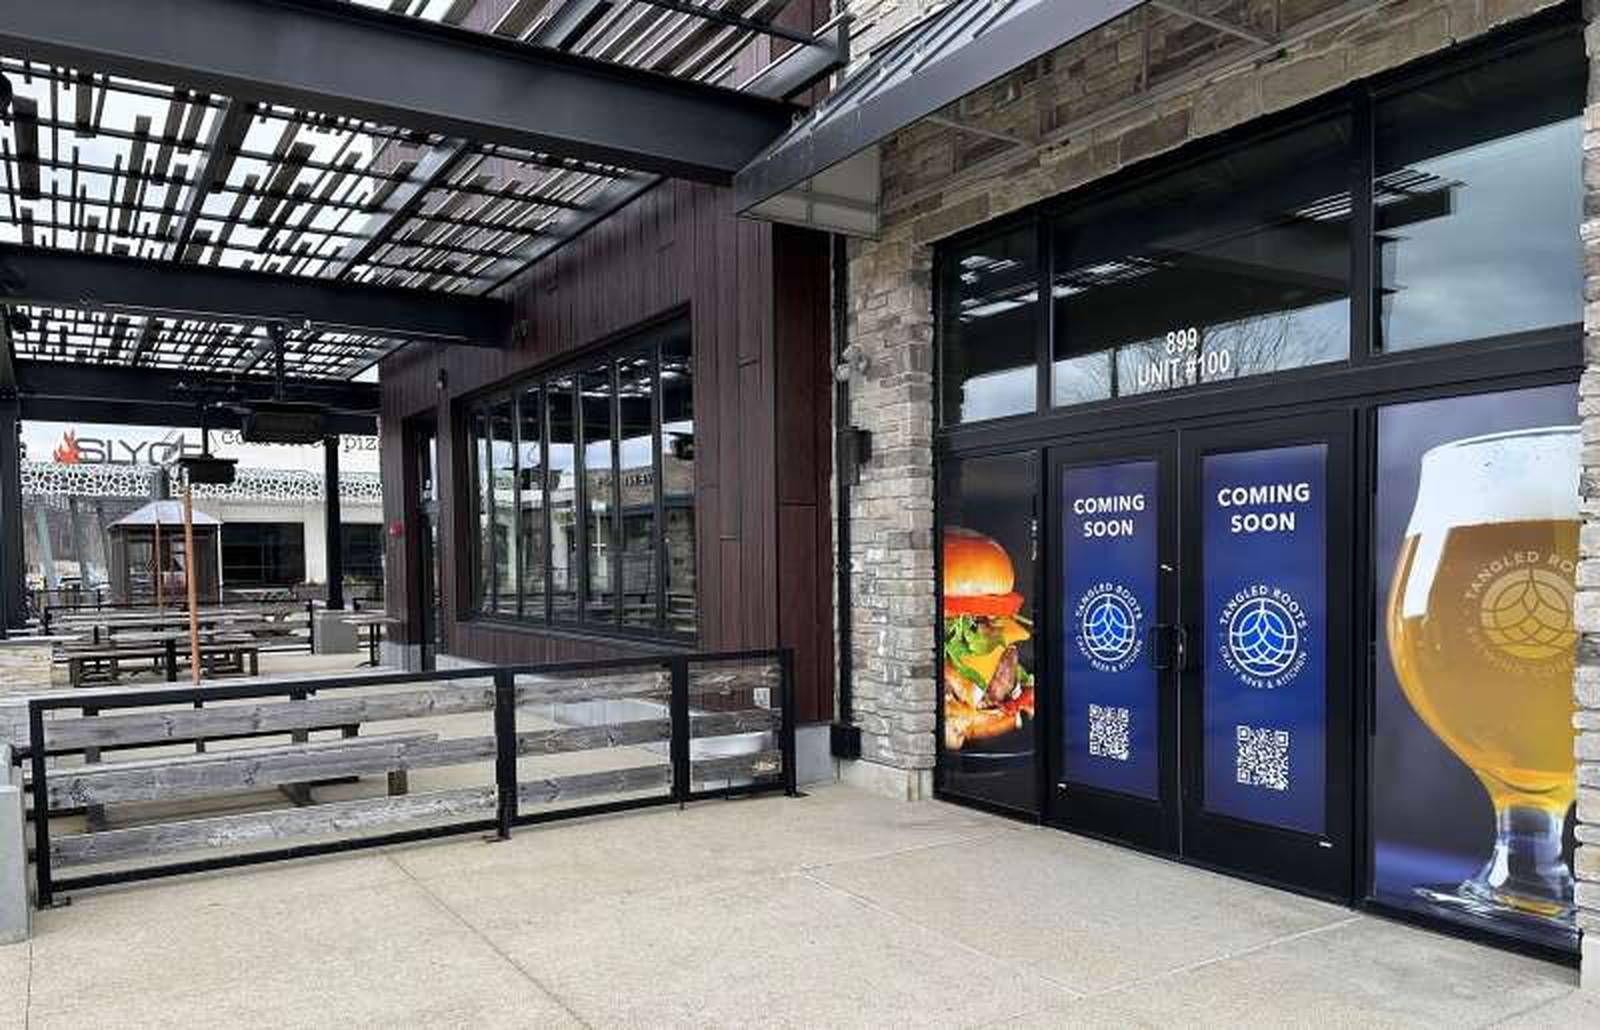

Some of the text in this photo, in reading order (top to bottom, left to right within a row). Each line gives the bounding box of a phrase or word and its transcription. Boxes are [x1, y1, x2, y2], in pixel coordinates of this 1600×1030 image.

[1166, 327, 1197, 354] 899
[1138, 349, 1230, 386] UNIT #100
[343, 436, 378, 453] piz
[1073, 493, 1145, 515] COMING
[1217, 482, 1310, 507] COMING
[1084, 519, 1133, 538] SOON
[1231, 511, 1295, 533] SOON
[1464, 550, 1540, 600] TANGLED
[1220, 585, 1308, 629] TANGLED ROOTS
